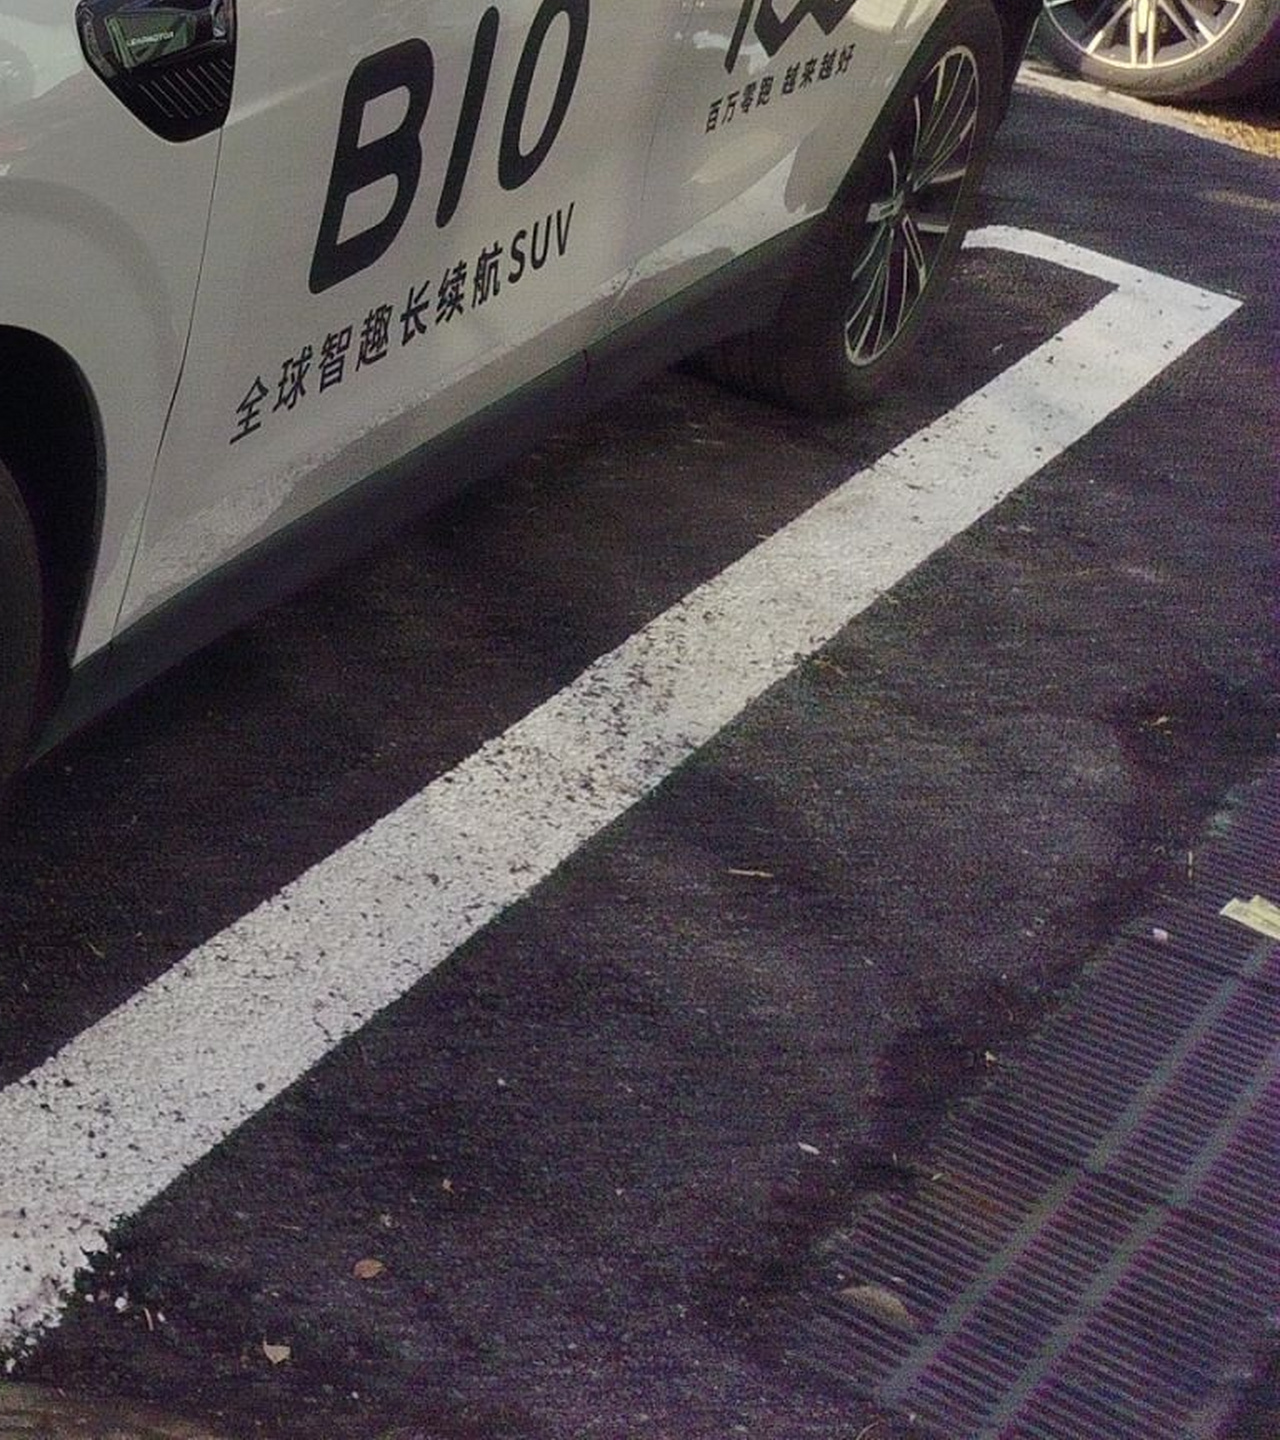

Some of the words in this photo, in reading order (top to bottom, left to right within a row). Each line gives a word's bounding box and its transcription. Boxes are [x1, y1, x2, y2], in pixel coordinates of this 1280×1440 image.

[230, 201, 576, 445] 全球智趣长续航SUV
